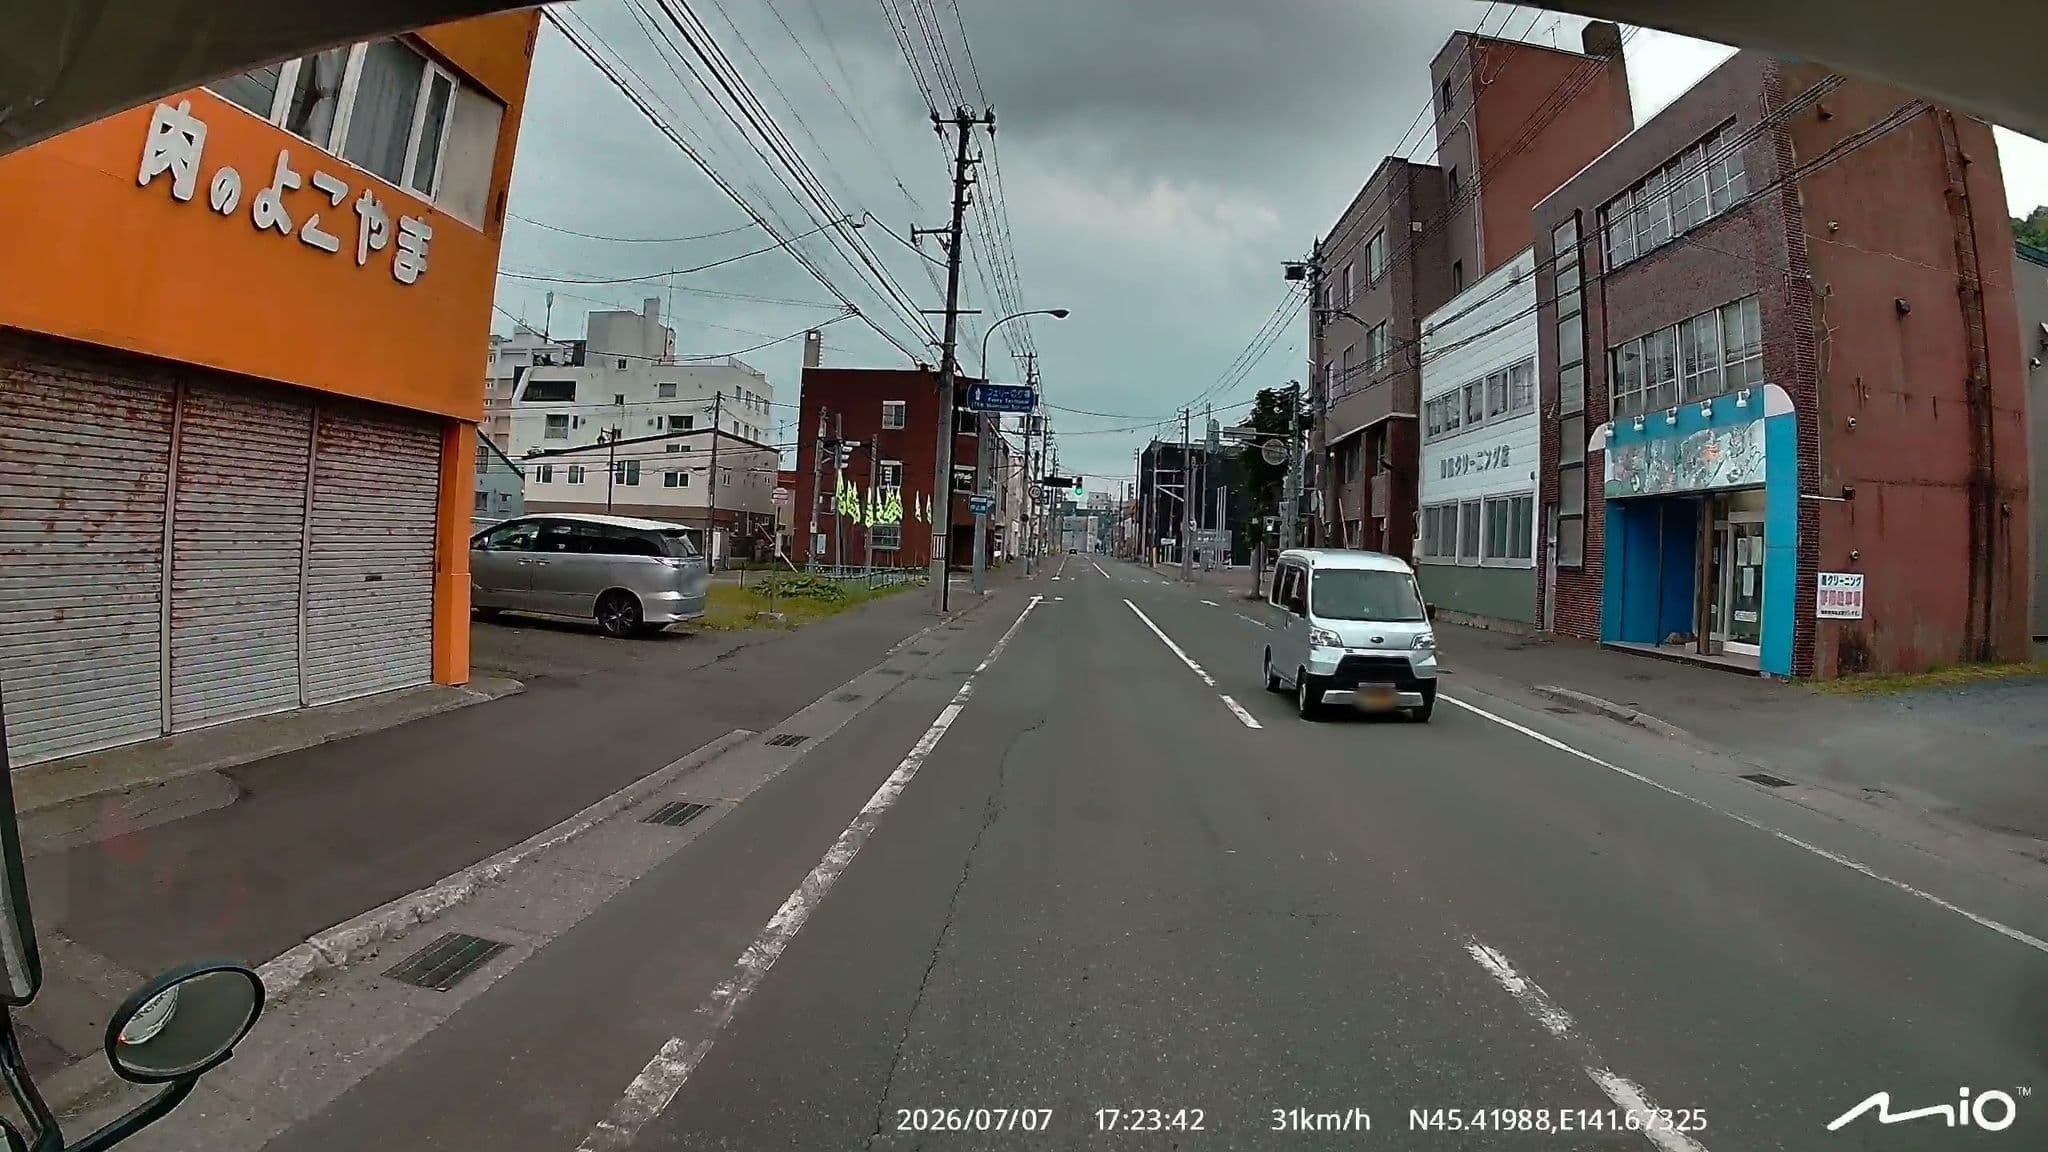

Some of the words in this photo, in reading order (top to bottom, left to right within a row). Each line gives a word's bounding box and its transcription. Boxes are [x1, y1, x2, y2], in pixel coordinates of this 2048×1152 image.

[138, 98, 432, 284] 肉のよこやま
